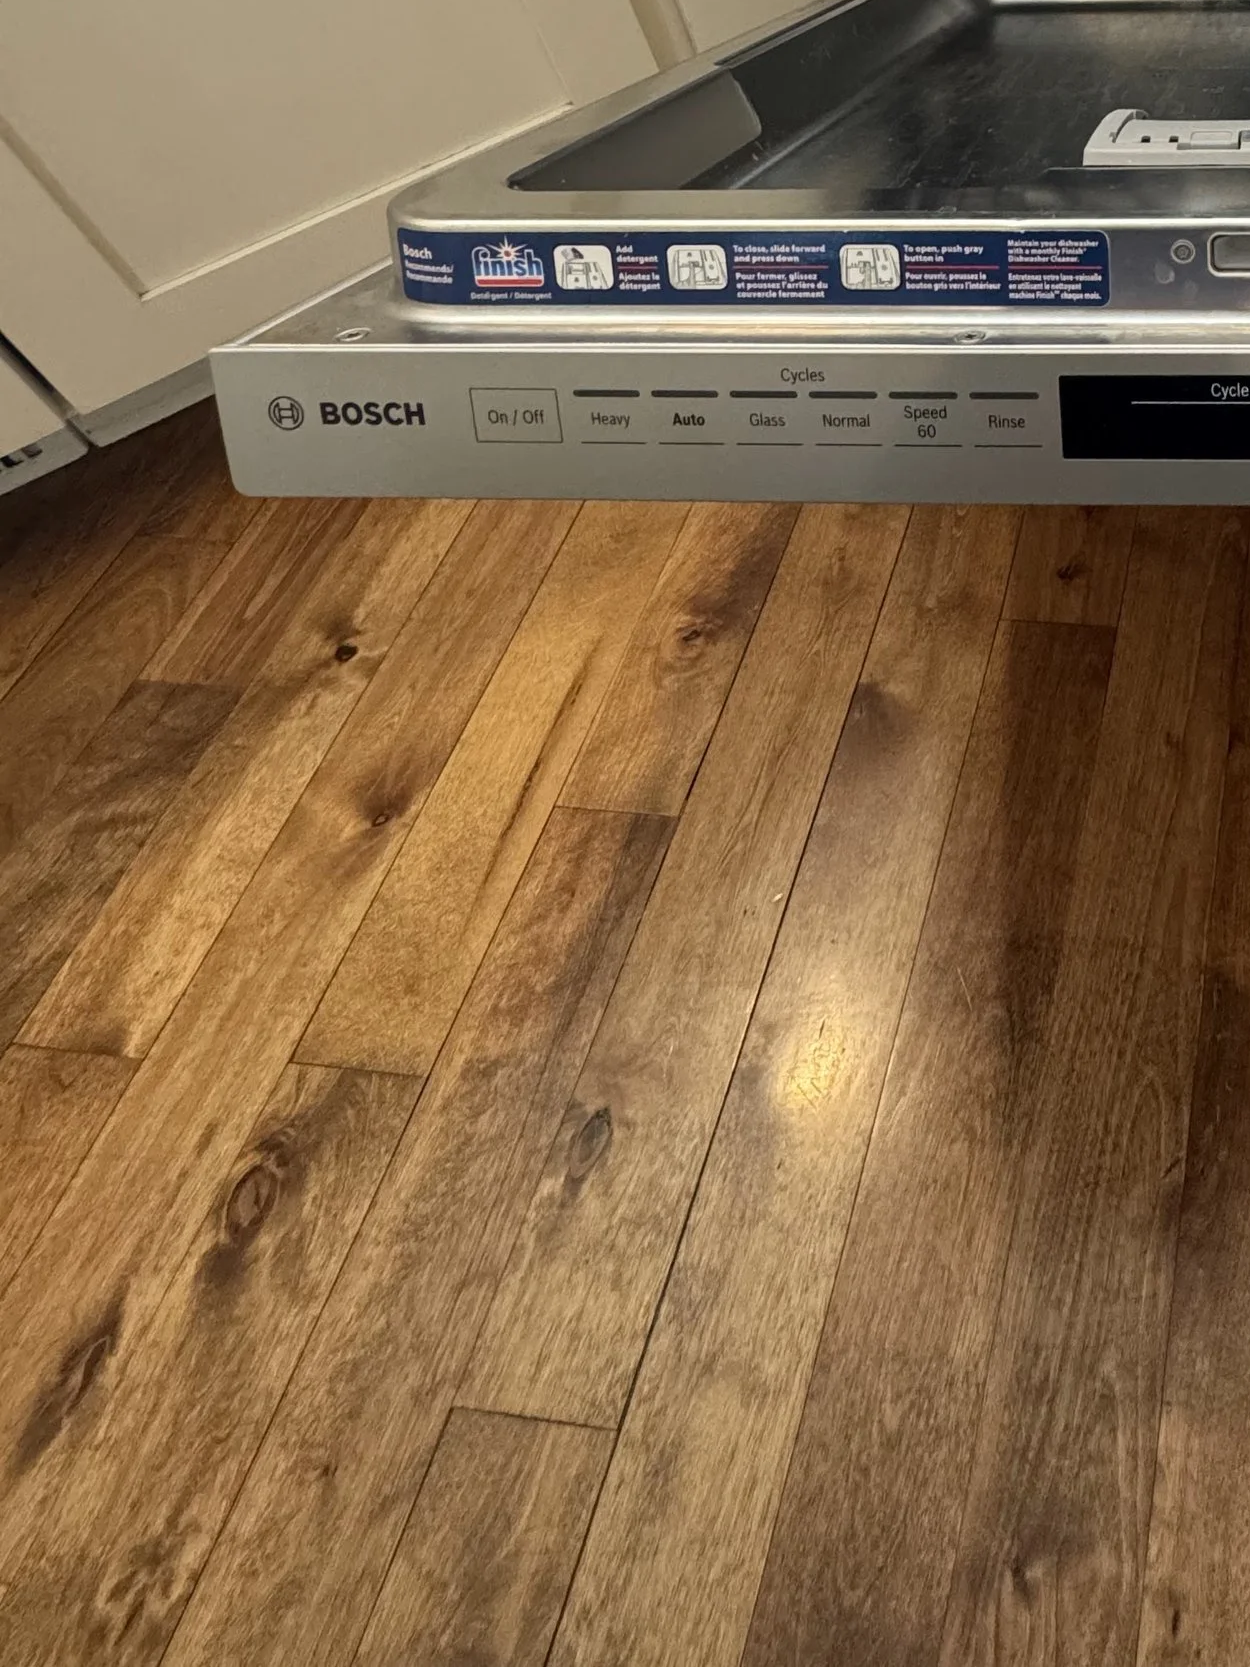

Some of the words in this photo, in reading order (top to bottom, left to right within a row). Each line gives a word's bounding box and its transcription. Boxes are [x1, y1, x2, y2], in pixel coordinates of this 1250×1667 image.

[403, 243, 432, 259] Bosch
[616, 245, 633, 253] Add
[733, 245, 743, 253] To
[744, 245, 768, 254] close,
[770, 245, 790, 253] slide
[791, 244, 826, 253] forward
[903, 244, 914, 253] To
[941, 244, 963, 254] push
[964, 246, 984, 254] gray
[616, 255, 658, 264] detergent
[734, 254, 750, 262] and
[752, 255, 774, 264] press
[776, 254, 800, 262] down
[904, 254, 934, 262] button
[934, 254, 944, 262] in
[619, 272, 650, 282] Ajoutez
[651, 272, 660, 280] le
[780, 368, 825, 383] Cycles
[1210, 382, 1249, 399] Cycle
[320, 402, 426, 426] BOSCH
[487, 409, 508, 424] On
[512, 410, 518, 425] /
[523, 409, 544, 424] Off
[591, 412, 630, 428] Heavy
[672, 413, 705, 427] Auto
[749, 413, 786, 428] Glass
[822, 413, 871, 428] Normal
[904, 405, 947, 424] Speed
[988, 415, 1025, 429] Rinse
[917, 424, 936, 438] 60
